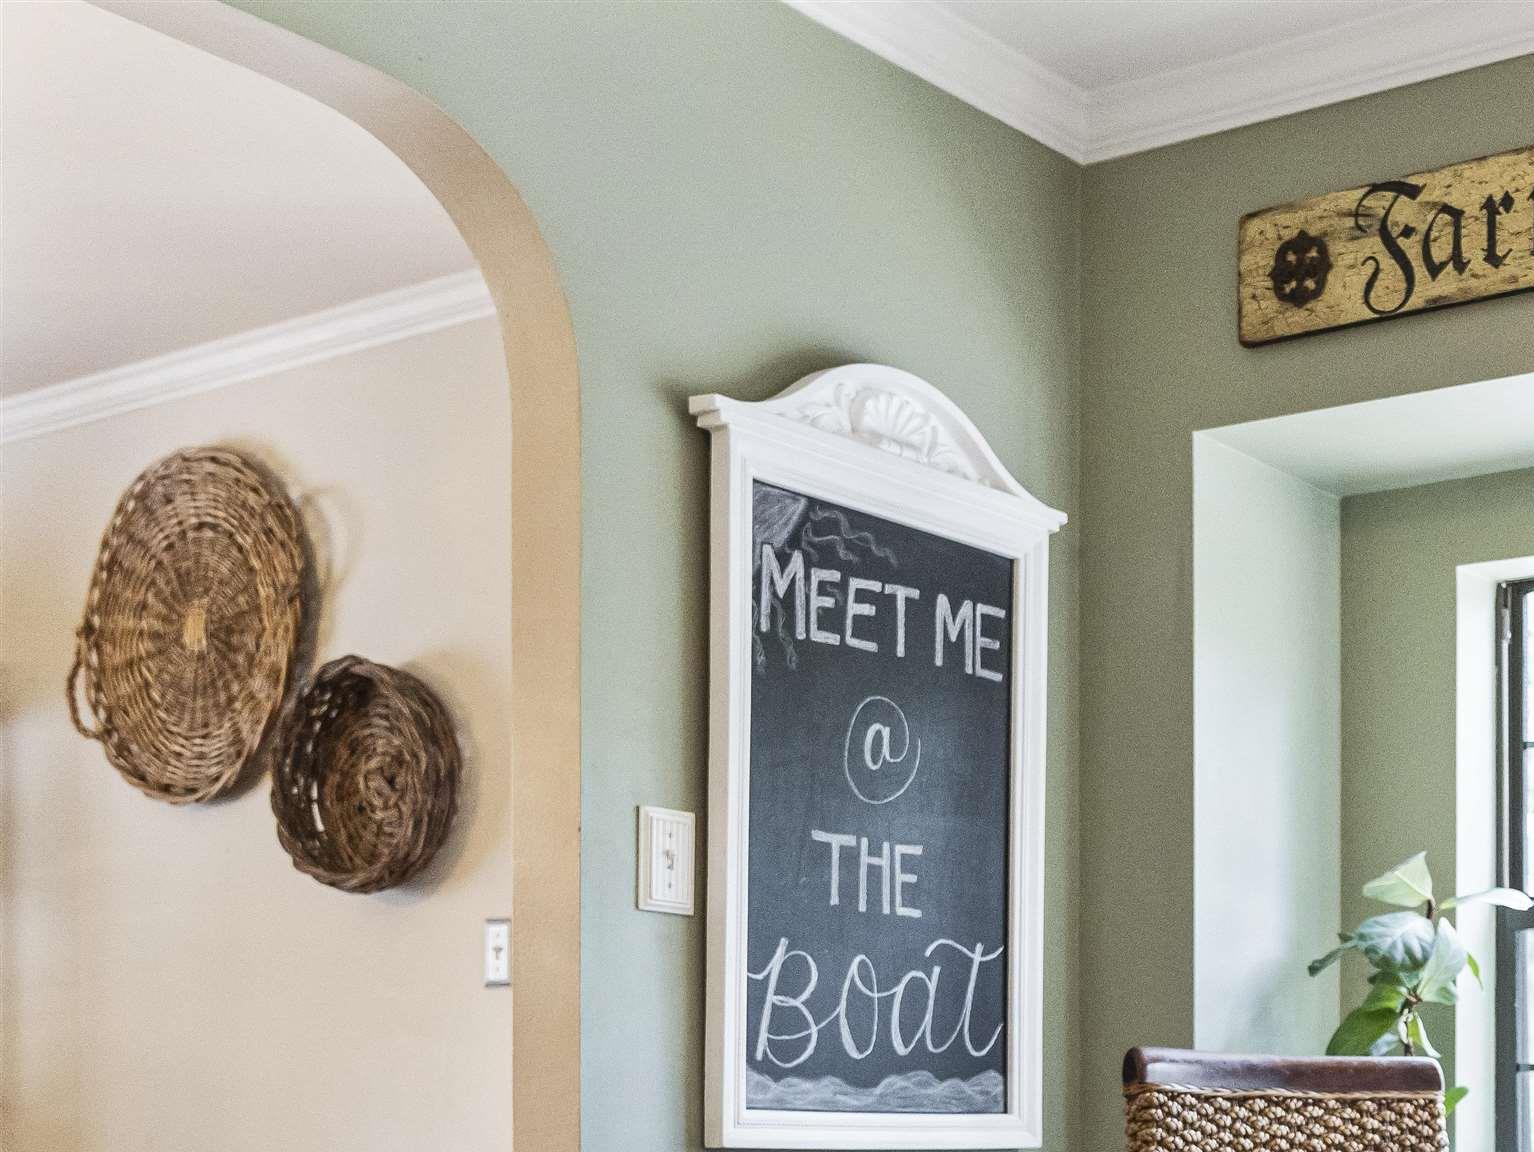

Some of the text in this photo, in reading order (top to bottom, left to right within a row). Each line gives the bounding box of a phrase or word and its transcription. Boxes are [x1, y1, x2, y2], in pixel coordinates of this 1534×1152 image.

[759, 543, 1006, 682] MEET ME
[844, 695, 921, 805] @
[811, 828, 924, 919] THE
